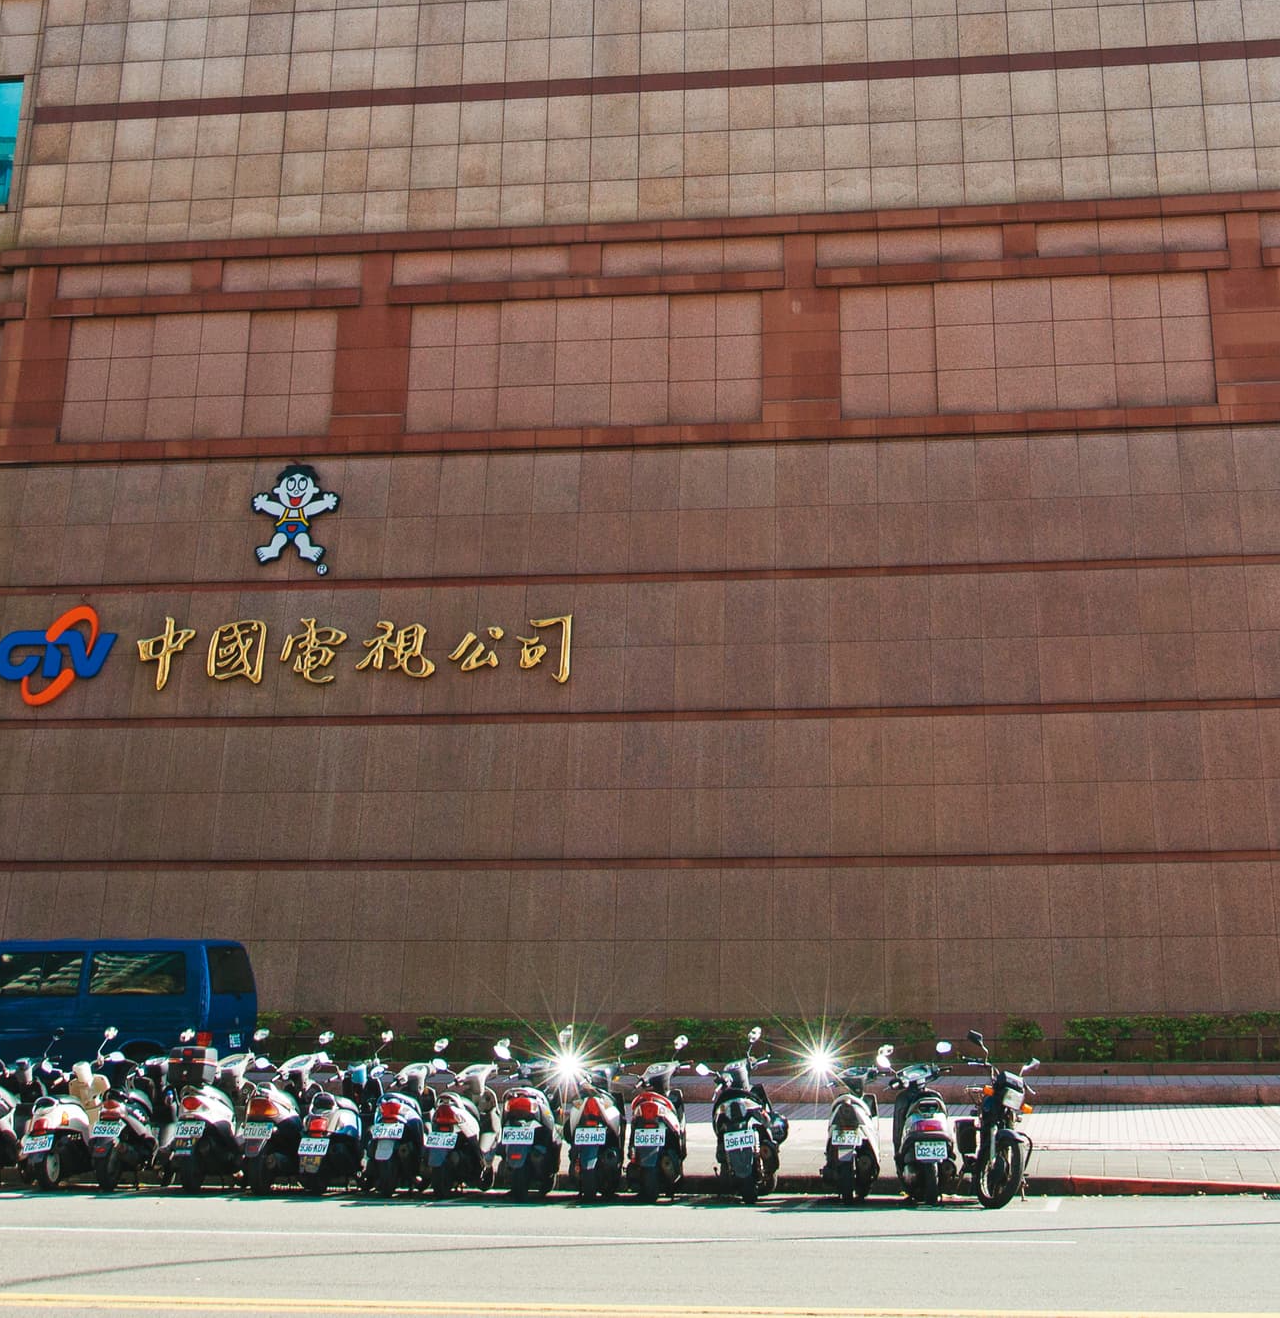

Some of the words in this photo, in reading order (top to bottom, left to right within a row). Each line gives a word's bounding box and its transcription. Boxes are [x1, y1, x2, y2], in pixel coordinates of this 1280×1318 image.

[137, 614, 573, 691] 中國電視公司
